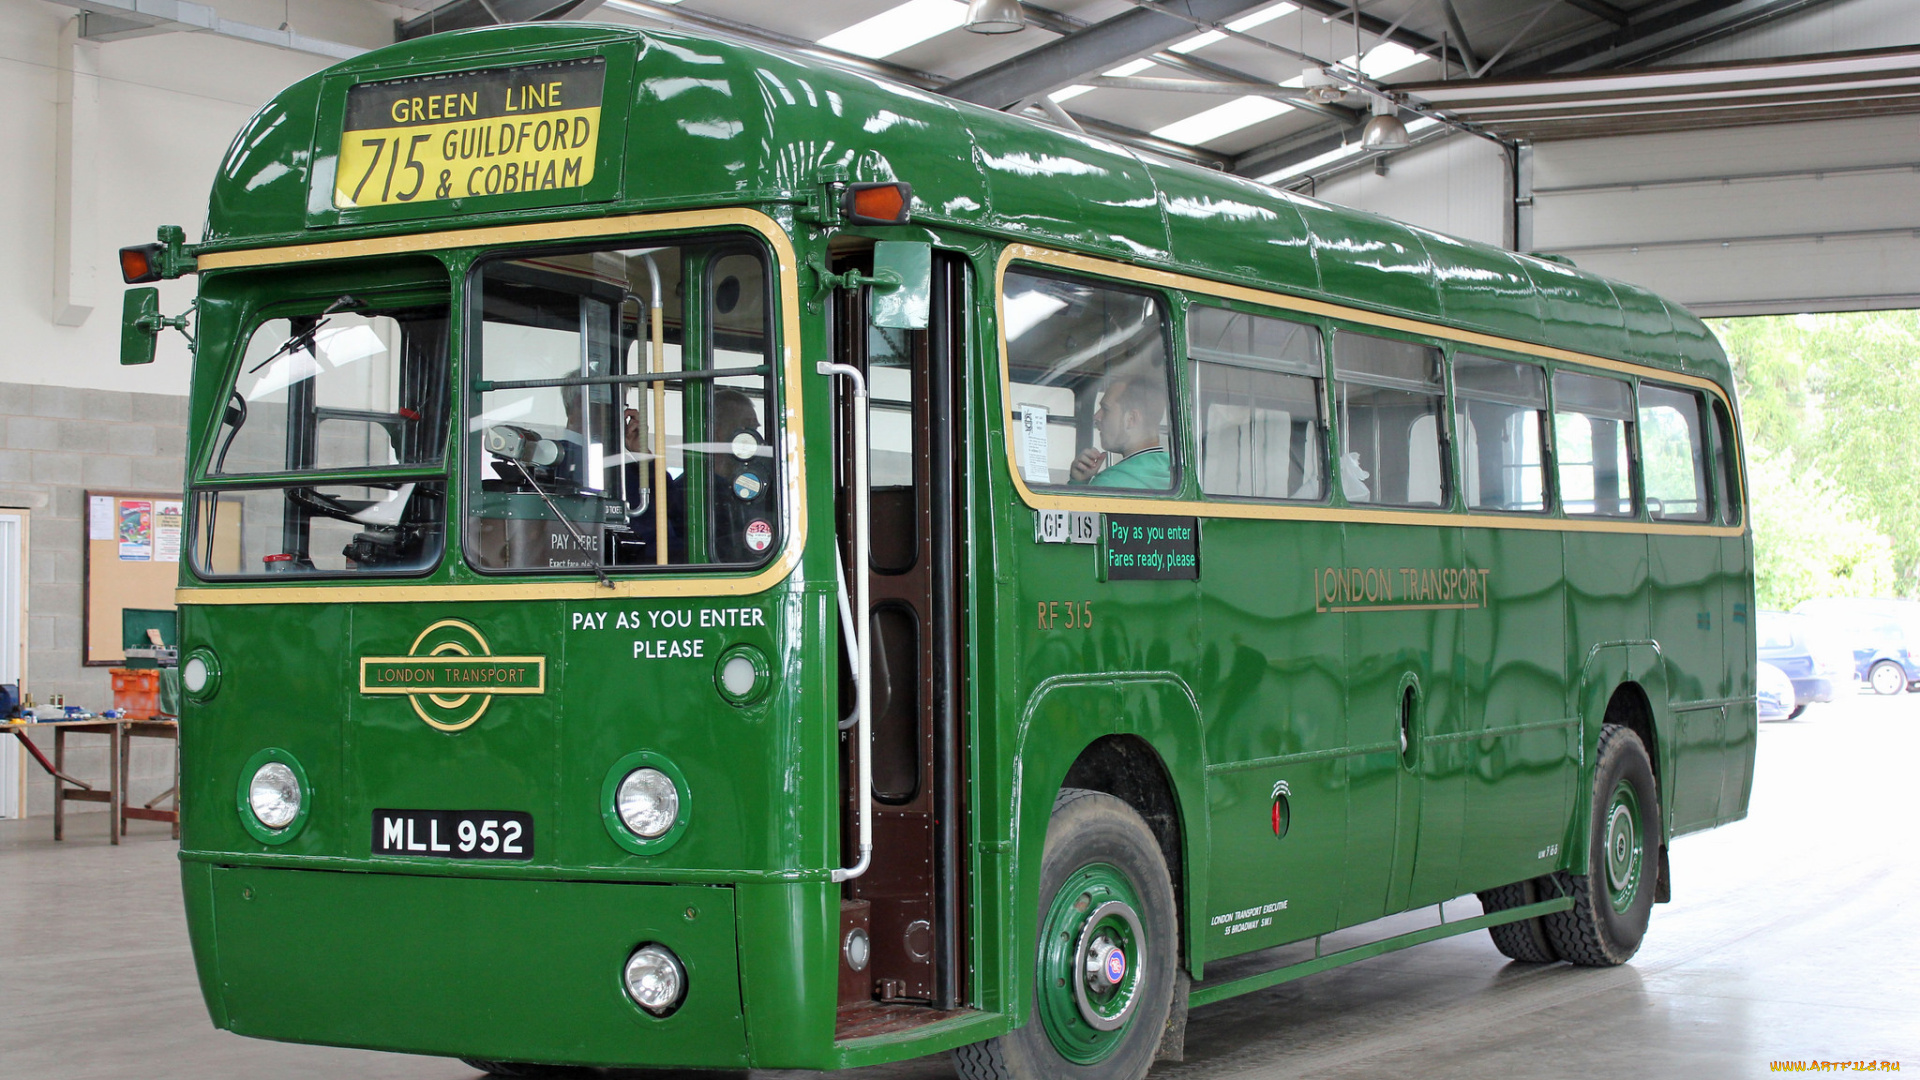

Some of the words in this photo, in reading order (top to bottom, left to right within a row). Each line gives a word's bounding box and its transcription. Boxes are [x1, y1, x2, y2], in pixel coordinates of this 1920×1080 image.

[391, 91, 478, 123] GREEN
[505, 82, 563, 112] LINE
[442, 116, 590, 161] GUILDFORD
[352, 134, 433, 205] 715
[435, 169, 453, 199] &
[467, 156, 583, 196] COBHAM
[1044, 513, 1064, 538] GF
[1111, 521, 1130, 545] Pay
[1132, 527, 1144, 540] as
[1147, 527, 1164, 545] you
[1167, 525, 1191, 541] enter
[551, 533, 569, 549] PAY
[549, 558, 567, 567] Exact
[1108, 549, 1135, 567] Fares
[1137, 550, 1165, 572] ready,
[1167, 551, 1196, 572] please
[1314, 567, 1392, 613] LONDON
[1398, 567, 1490, 608] TRANSPORT
[572, 612, 608, 630] PAY
[615, 611, 641, 629] AS
[648, 610, 692, 628] YOU
[700, 608, 765, 628] ENTER
[1038, 601, 1059, 630] RF
[1064, 600, 1093, 629] 315
[633, 639, 704, 659] PLEASE
[377, 668, 435, 683] LONDON
[445, 668, 526, 683] TRANSPORT
[383, 817, 451, 852] MLL
[457, 819, 523, 854] 952
[1211, 912, 1234, 926] LONDON
[1234, 906, 1263, 921] TRANSPORT
[1262, 900, 1288, 914] EXECUTIVE
[1231, 920, 1260, 934] BROADWAY
